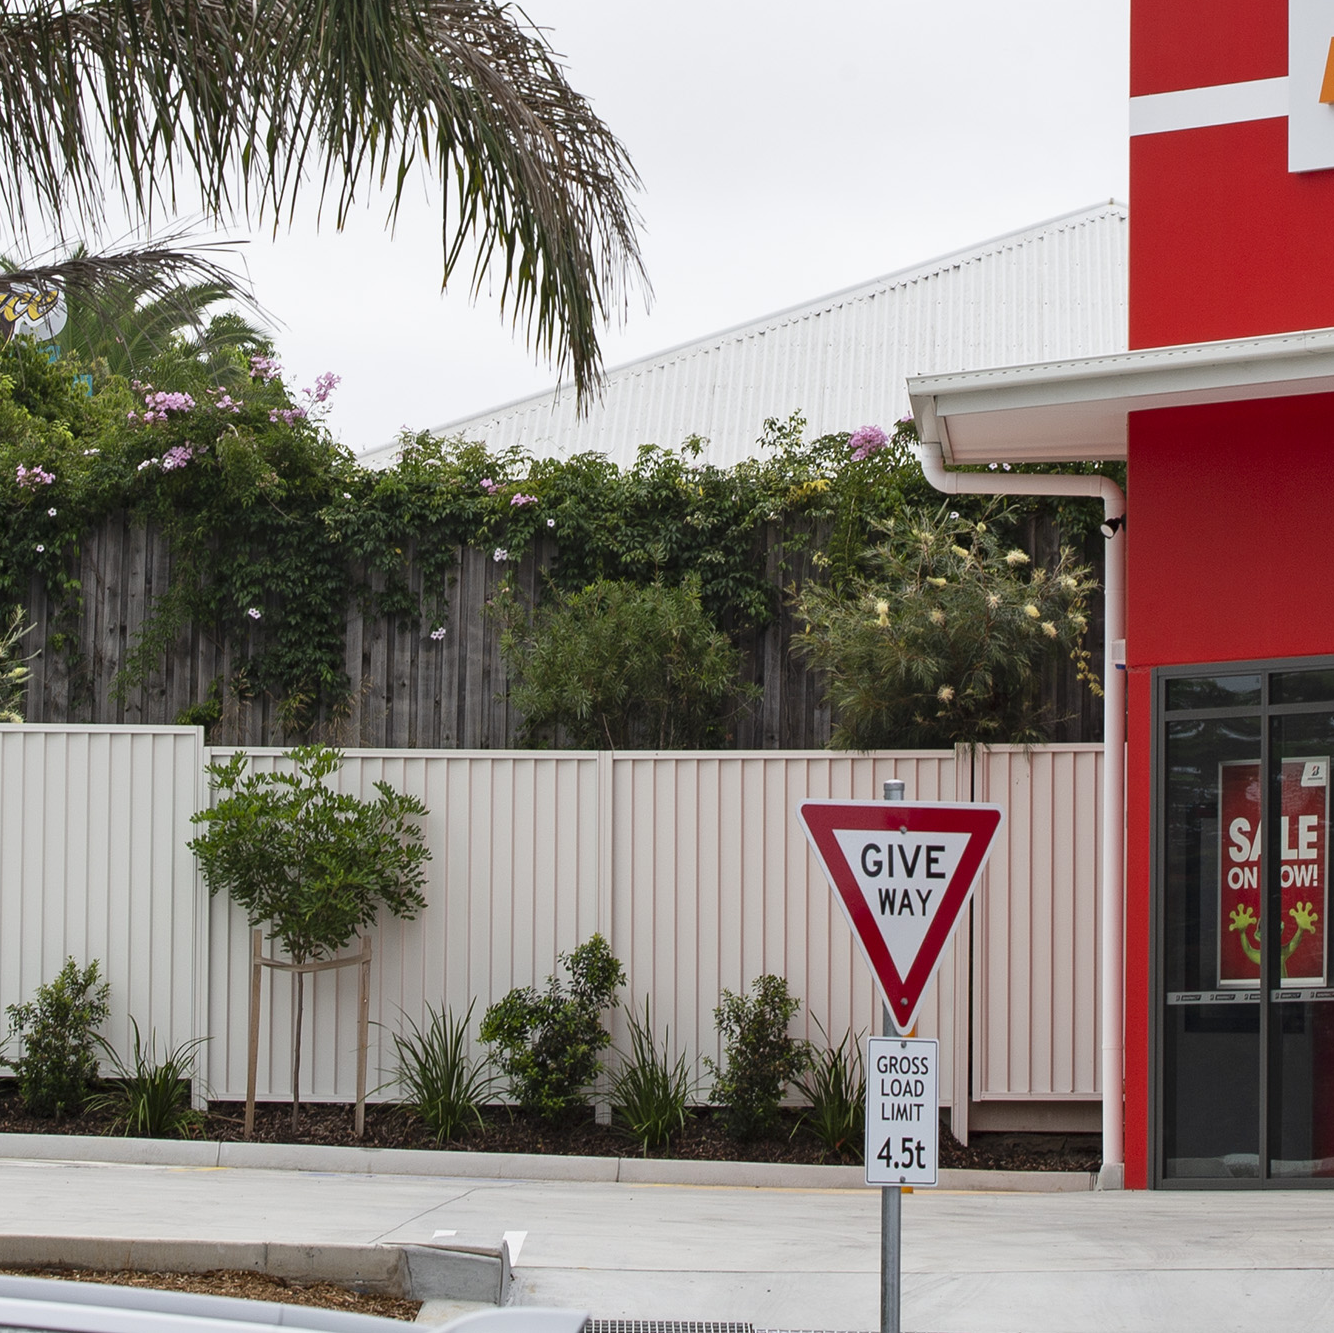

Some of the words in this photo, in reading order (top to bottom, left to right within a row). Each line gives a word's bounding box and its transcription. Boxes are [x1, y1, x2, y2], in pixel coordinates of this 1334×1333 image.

[861, 843, 946, 879] GIVE
[1227, 866, 1258, 890] ON
[1280, 864, 1318, 888] OW!
[878, 888, 933, 916] WAY
[877, 1055, 929, 1075] GROSS
[881, 1078, 924, 1098] LOAD
[881, 1102, 925, 1122] LIMIT
[877, 1137, 926, 1169] 4.5t
